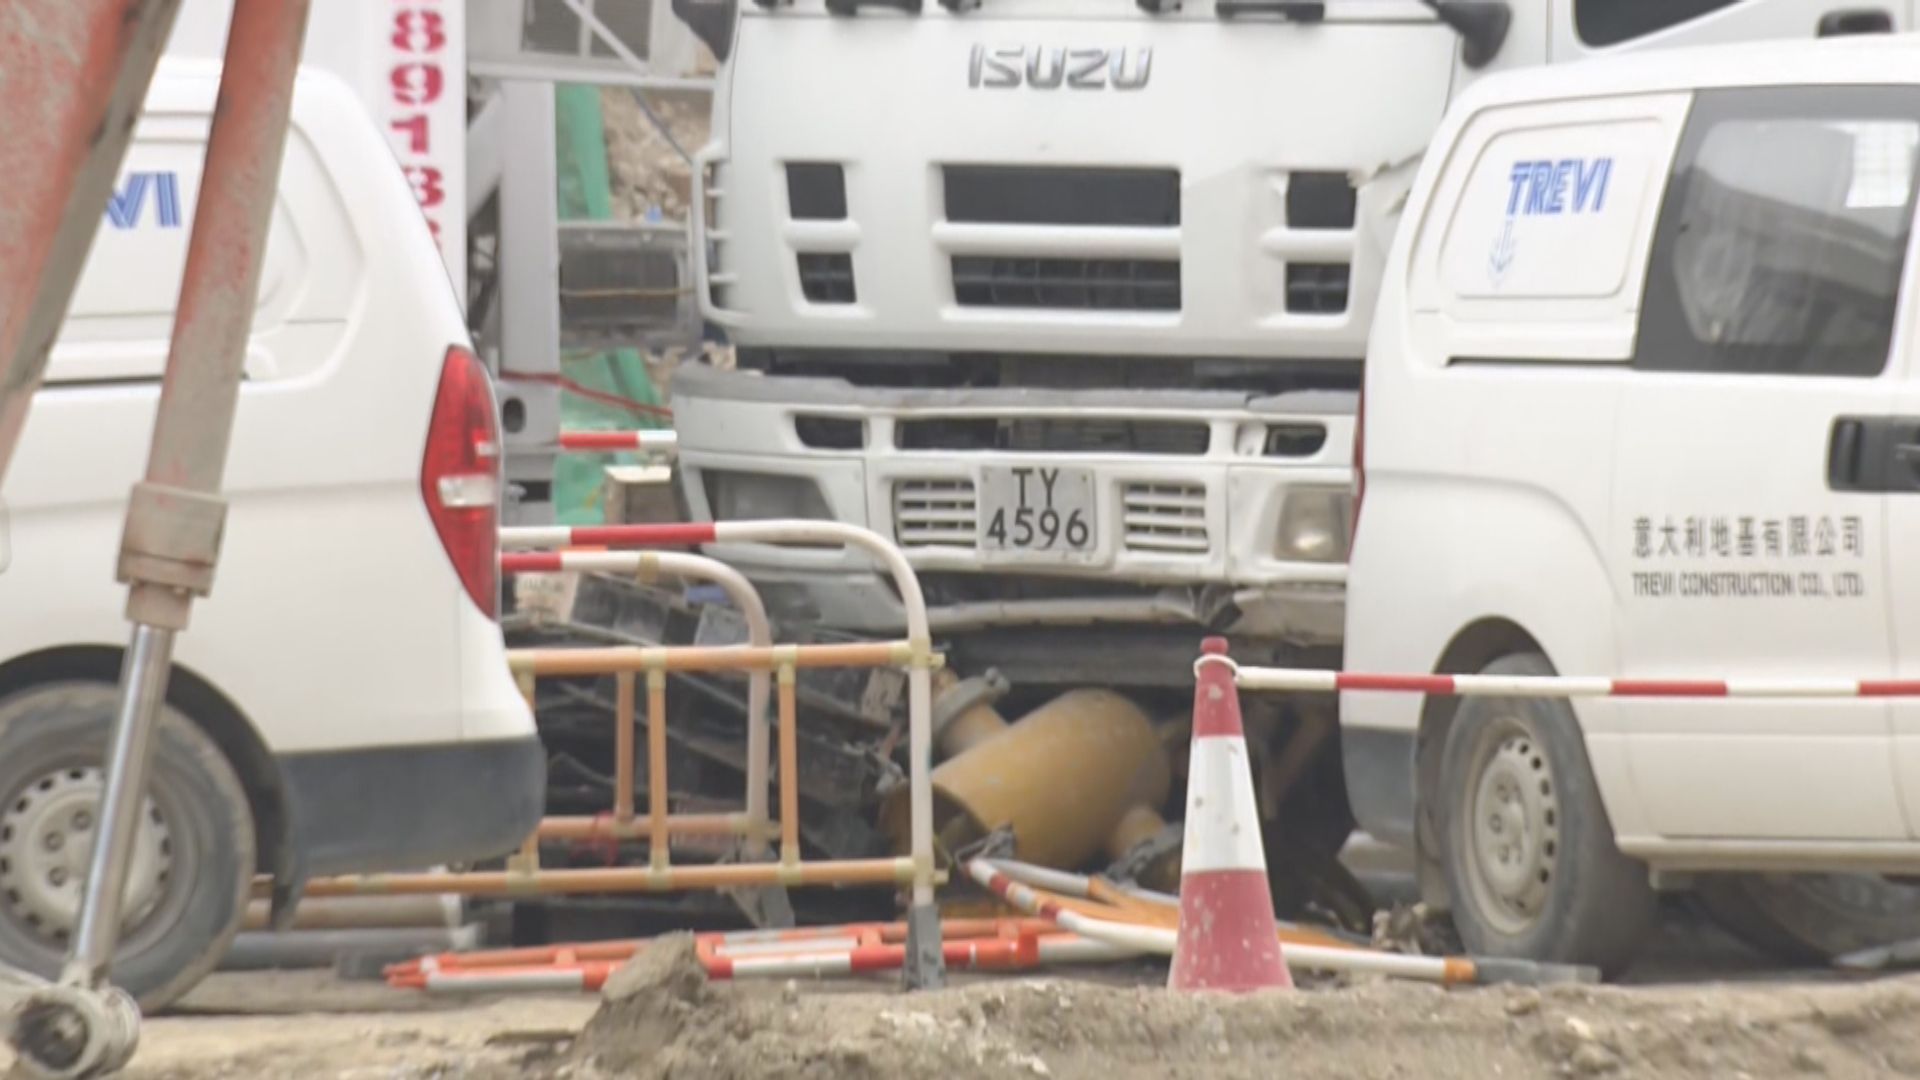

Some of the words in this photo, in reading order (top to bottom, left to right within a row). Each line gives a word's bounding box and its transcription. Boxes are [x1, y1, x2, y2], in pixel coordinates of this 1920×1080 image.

[968, 44, 1152, 89] ISUZU
[1507, 158, 1612, 215] TREVI
[1012, 467, 1058, 508] TY
[986, 506, 1088, 550] 4596
[1633, 516, 1863, 557] 意大利地基有限公司
[1632, 572, 1675, 597] TREVI
[1679, 572, 1793, 597] CONSTRUCTION
